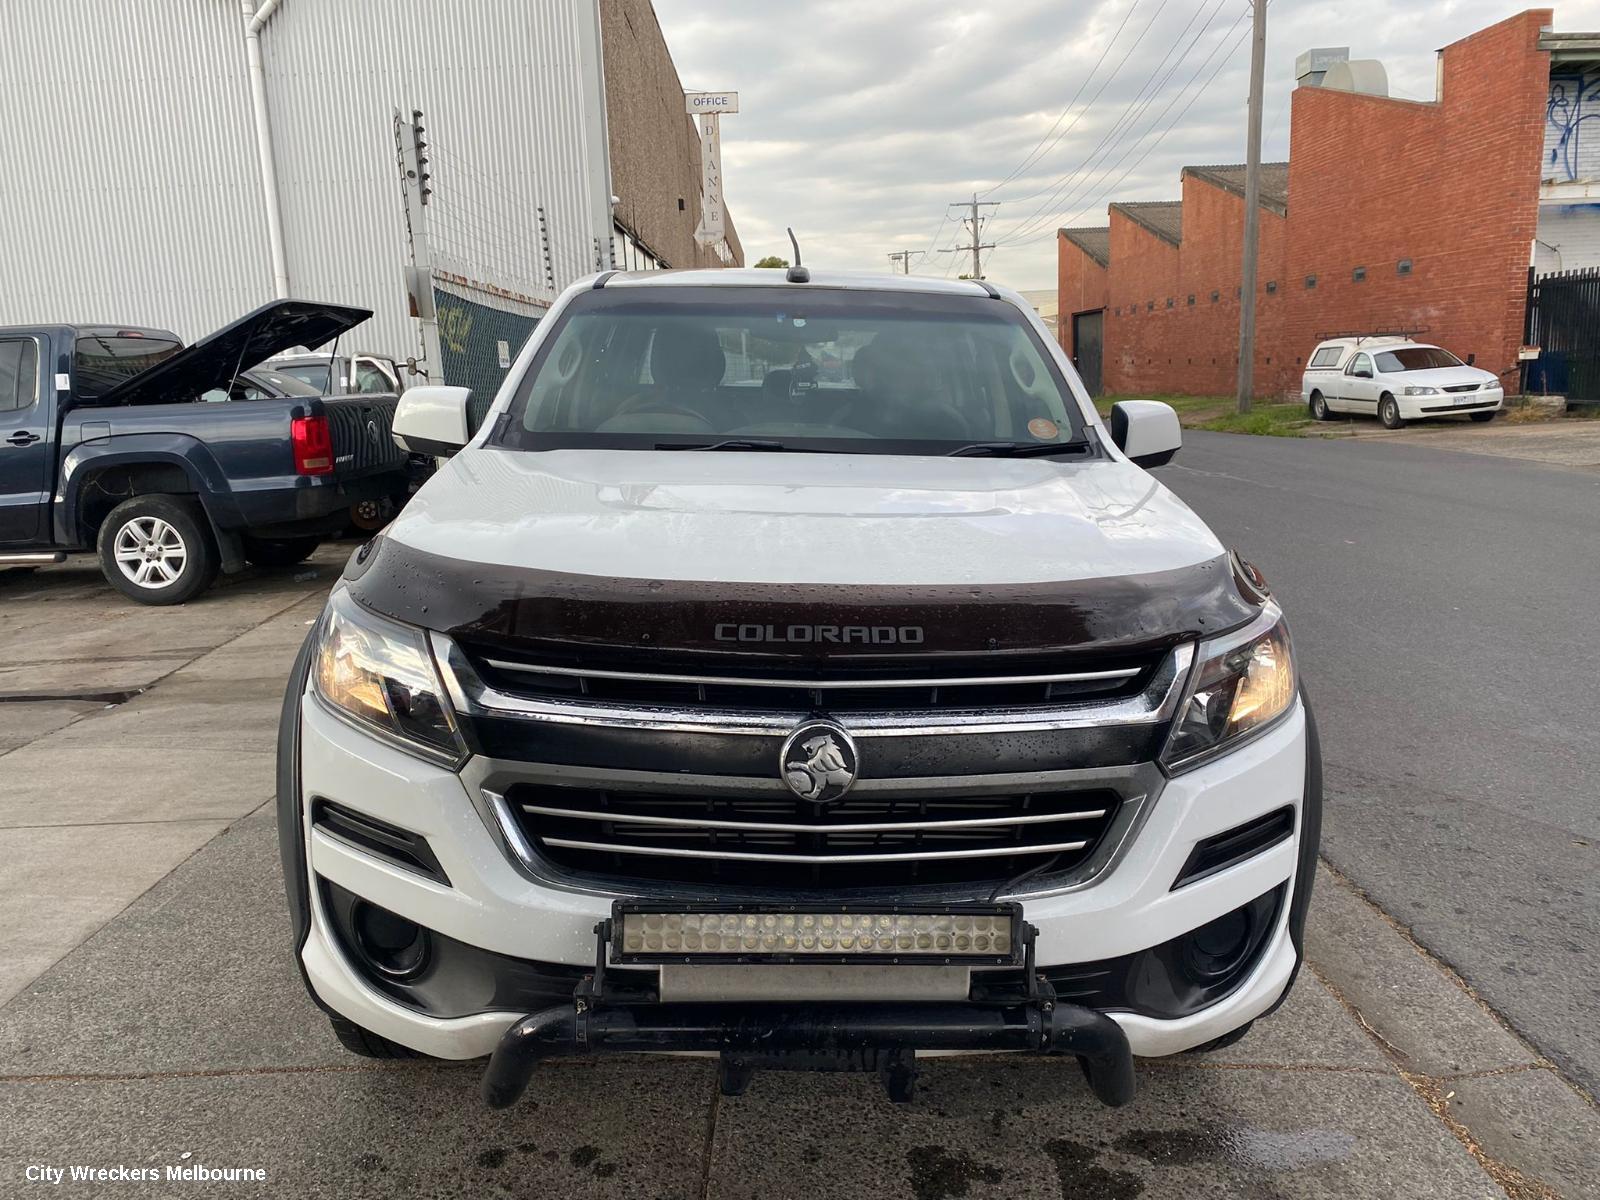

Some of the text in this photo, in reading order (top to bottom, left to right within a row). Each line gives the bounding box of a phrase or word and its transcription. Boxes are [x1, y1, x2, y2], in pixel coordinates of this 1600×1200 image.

[693, 97, 728, 106] OFFICE
[705, 126, 719, 222] DIANNE
[714, 623, 924, 644] COLORADO
